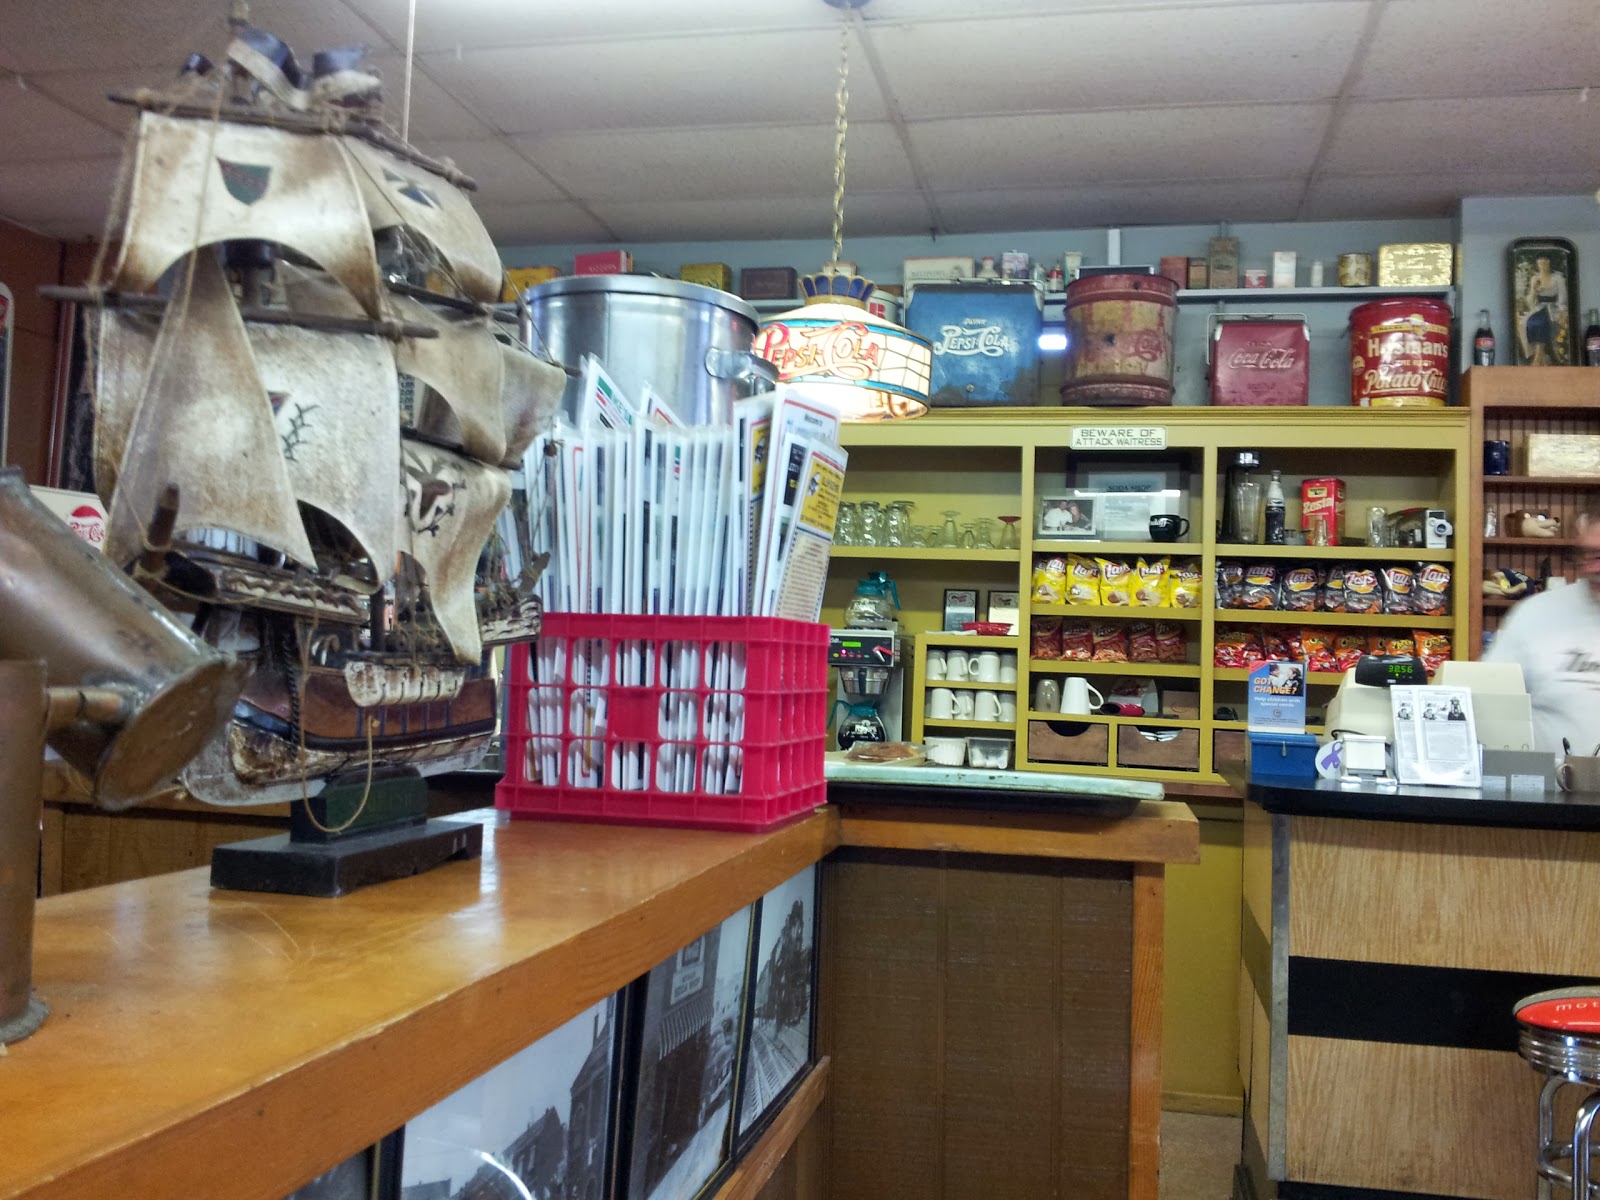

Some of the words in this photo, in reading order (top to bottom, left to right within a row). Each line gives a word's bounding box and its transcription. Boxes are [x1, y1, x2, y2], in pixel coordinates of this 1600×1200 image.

[1081, 429, 1134, 437] BEWARE
[1140, 429, 1156, 437] OF
[1076, 438, 1113, 446] ATTACK
[1116, 438, 1162, 446] WAITRESS
[1253, 677, 1272, 685] GOT
[1253, 685, 1298, 695] CHANGE?
